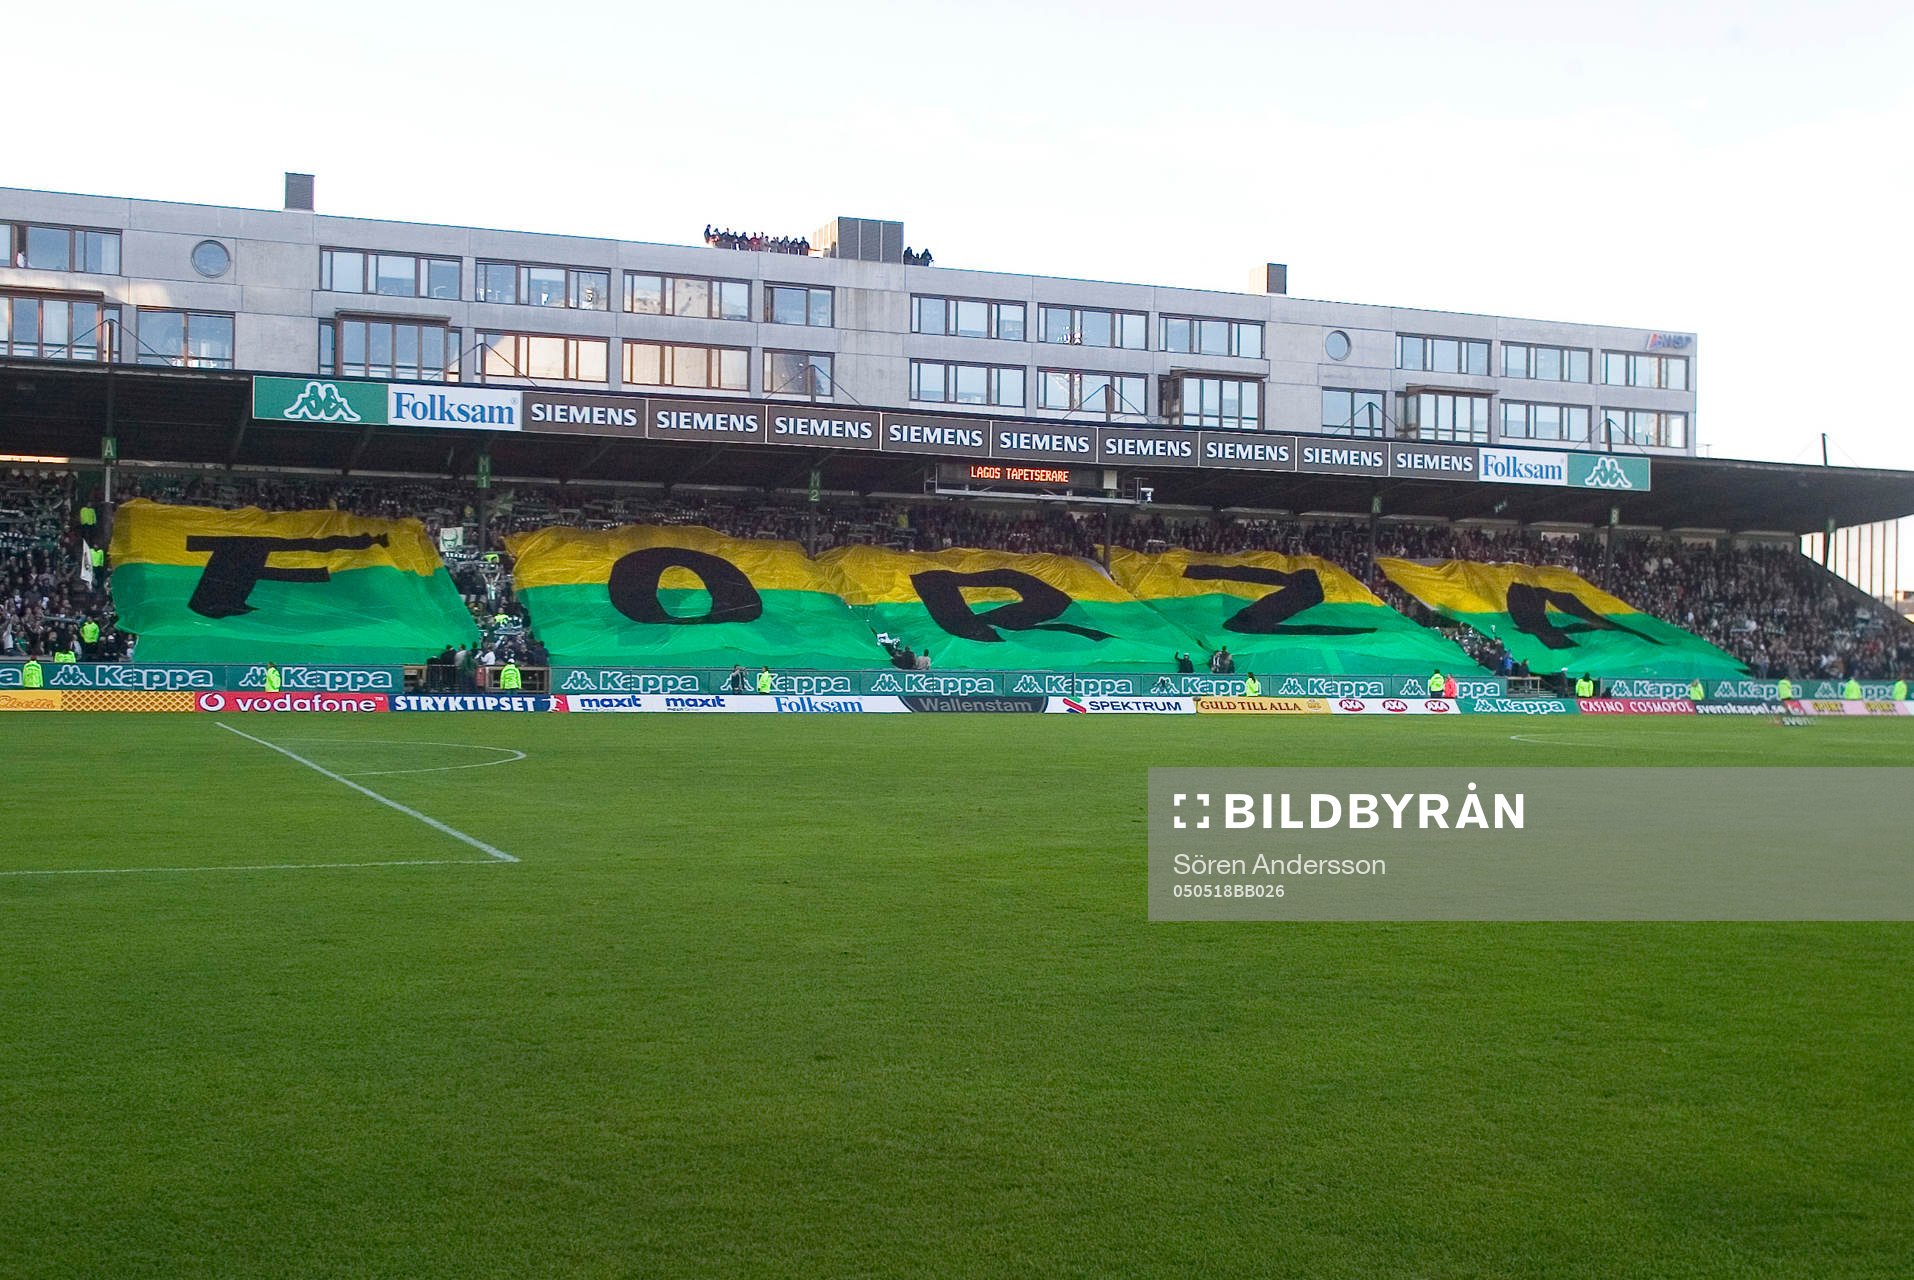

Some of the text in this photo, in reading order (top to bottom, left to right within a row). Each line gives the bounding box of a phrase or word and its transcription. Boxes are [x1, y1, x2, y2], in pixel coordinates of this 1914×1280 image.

[393, 391, 515, 425] Folksam
[532, 403, 638, 427] SIEMENS
[656, 410, 760, 433] SIEMENS
[774, 417, 873, 440] SIEMENS
[889, 424, 983, 447] SIEMENS
[1000, 431, 1090, 453] SIEMENS
[104, 439, 114, 457] A
[1106, 437, 1190, 460] SIEMENS
[1206, 442, 1290, 462] SIEMENS
[1303, 447, 1384, 467] SIEMENS
[1396, 452, 1474, 472] SIEMENS
[1483, 454, 1564, 481] Folksam
[971, 465, 1069, 483] LAGOS TAPETSERARE
[96, 665, 213, 690] Kappa
[281, 666, 392, 691] Kappa
[600, 671, 698, 693] Kappa
[905, 674, 994, 696] Kappa
[1045, 675, 1132, 697] Kappa
[1181, 676, 1261, 697] Kapp
[1307, 678, 1384, 698] Kappa
[1634, 680, 1691, 700] Kapp
[1739, 681, 1802, 700] Kapa
[236, 693, 377, 712] vodafone
[395, 695, 536, 712] STRYKTIPSET
[580, 694, 642, 708] maxit
[665, 695, 726, 708] maxit
[775, 696, 864, 713] Folksam
[919, 697, 1032, 712] Wallenstam
[1089, 700, 1182, 711] SPEKTRUM
[1201, 701, 1236, 710] GULD
[1238, 701, 1267, 711] TILL
[1270, 702, 1302, 711] ALLA
[1342, 699, 1363, 710] AXA
[1387, 700, 1407, 710] AXA
[1428, 700, 1450, 710] AXA
[1495, 698, 1565, 714] Kappa
[1579, 700, 1693, 713] CASINO COSMOPOL
